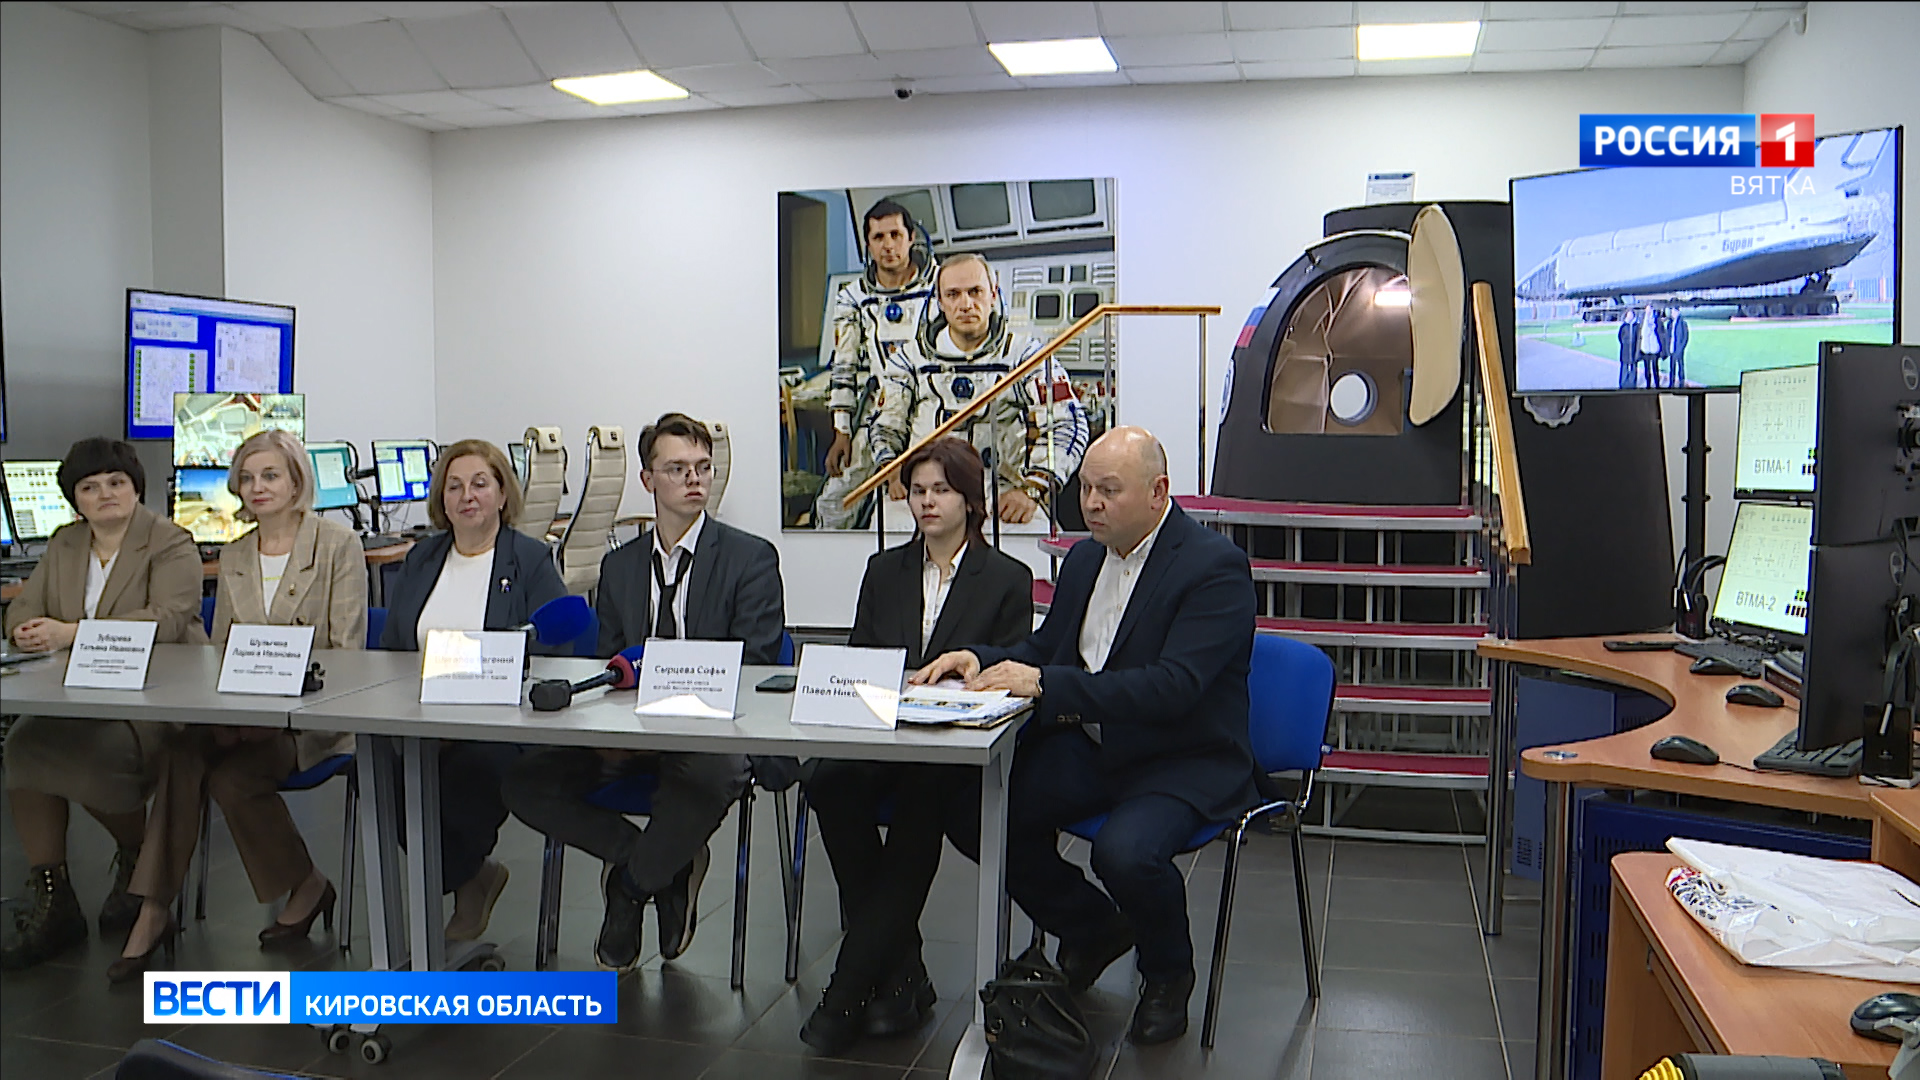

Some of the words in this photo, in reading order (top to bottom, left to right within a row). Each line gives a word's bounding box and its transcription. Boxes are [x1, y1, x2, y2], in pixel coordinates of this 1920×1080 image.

[1722, 237, 1753, 254] Буран
[1754, 459, 1791, 474] ВТМА-1
[1736, 591, 1776, 611] ВТМА-2
[654, 665, 695, 675] Сырцева
[697, 665, 727, 677] Софья
[802, 685, 831, 696] Павел
